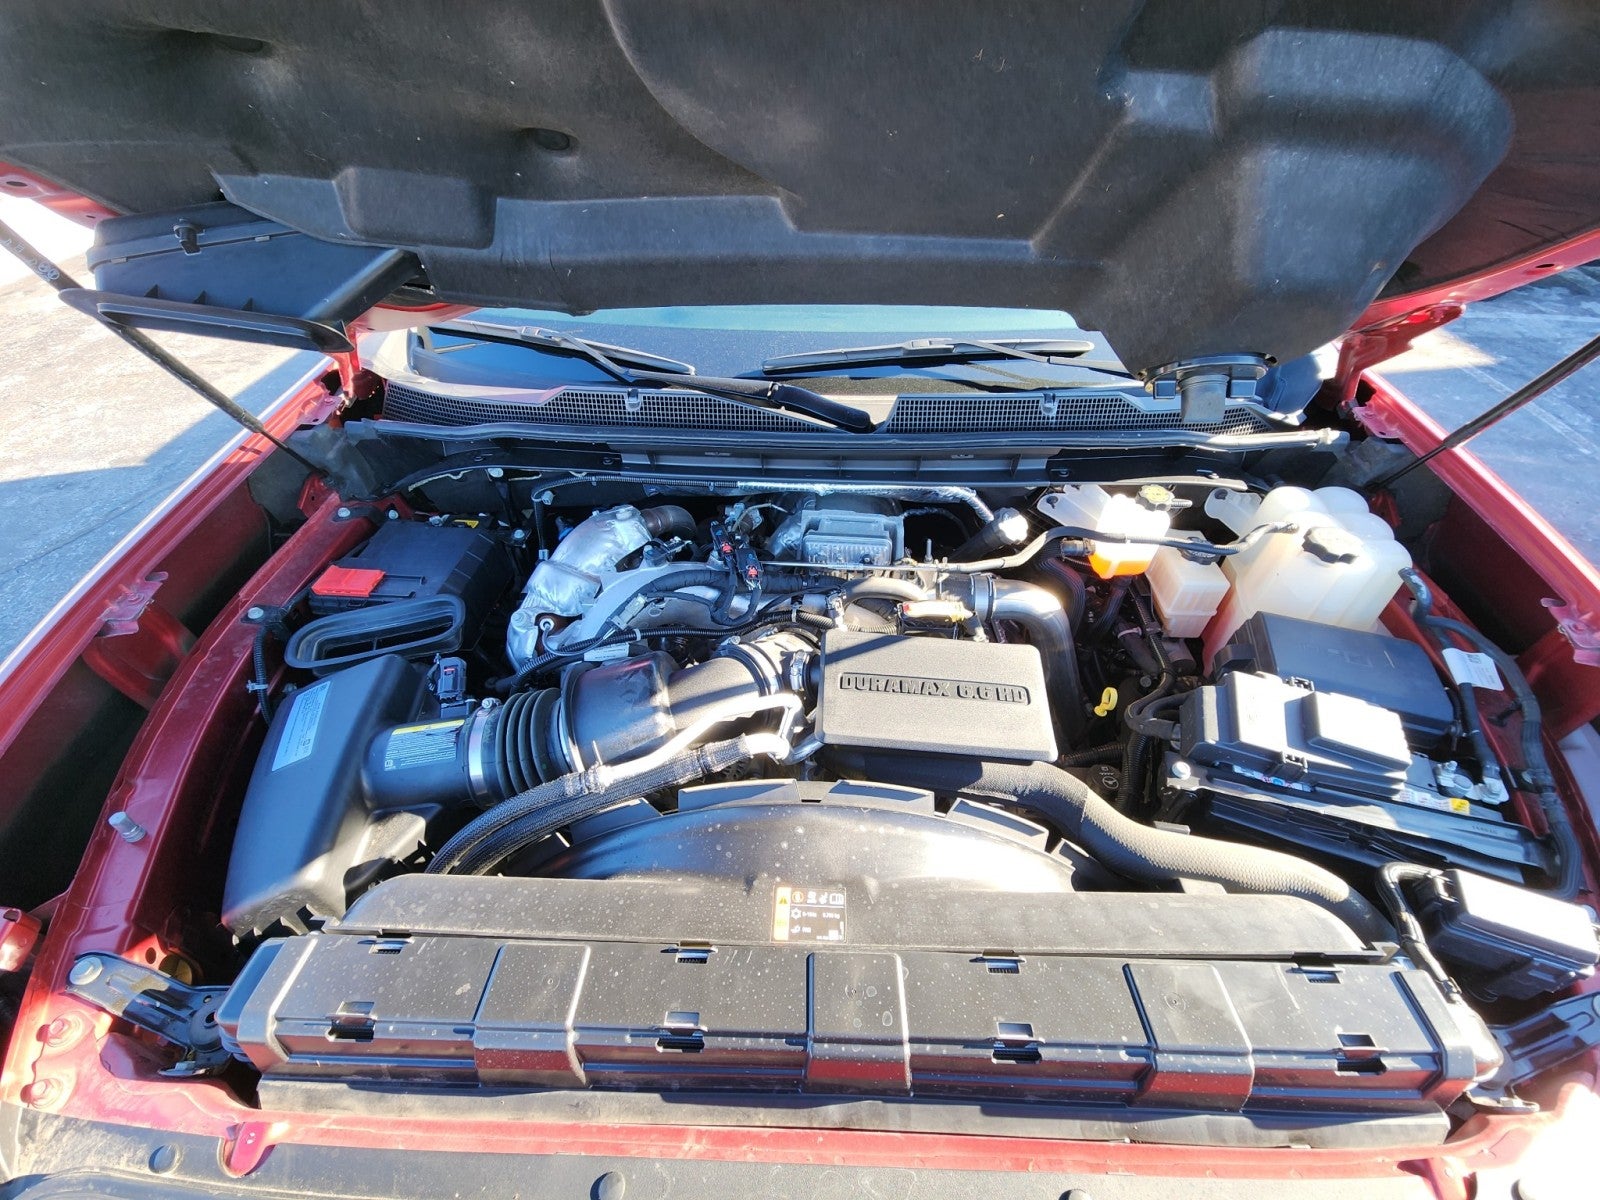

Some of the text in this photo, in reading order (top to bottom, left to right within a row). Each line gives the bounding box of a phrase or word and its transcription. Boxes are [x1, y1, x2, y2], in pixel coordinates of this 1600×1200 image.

[839, 674, 1027, 703] DURAMAX 6.6 HD
